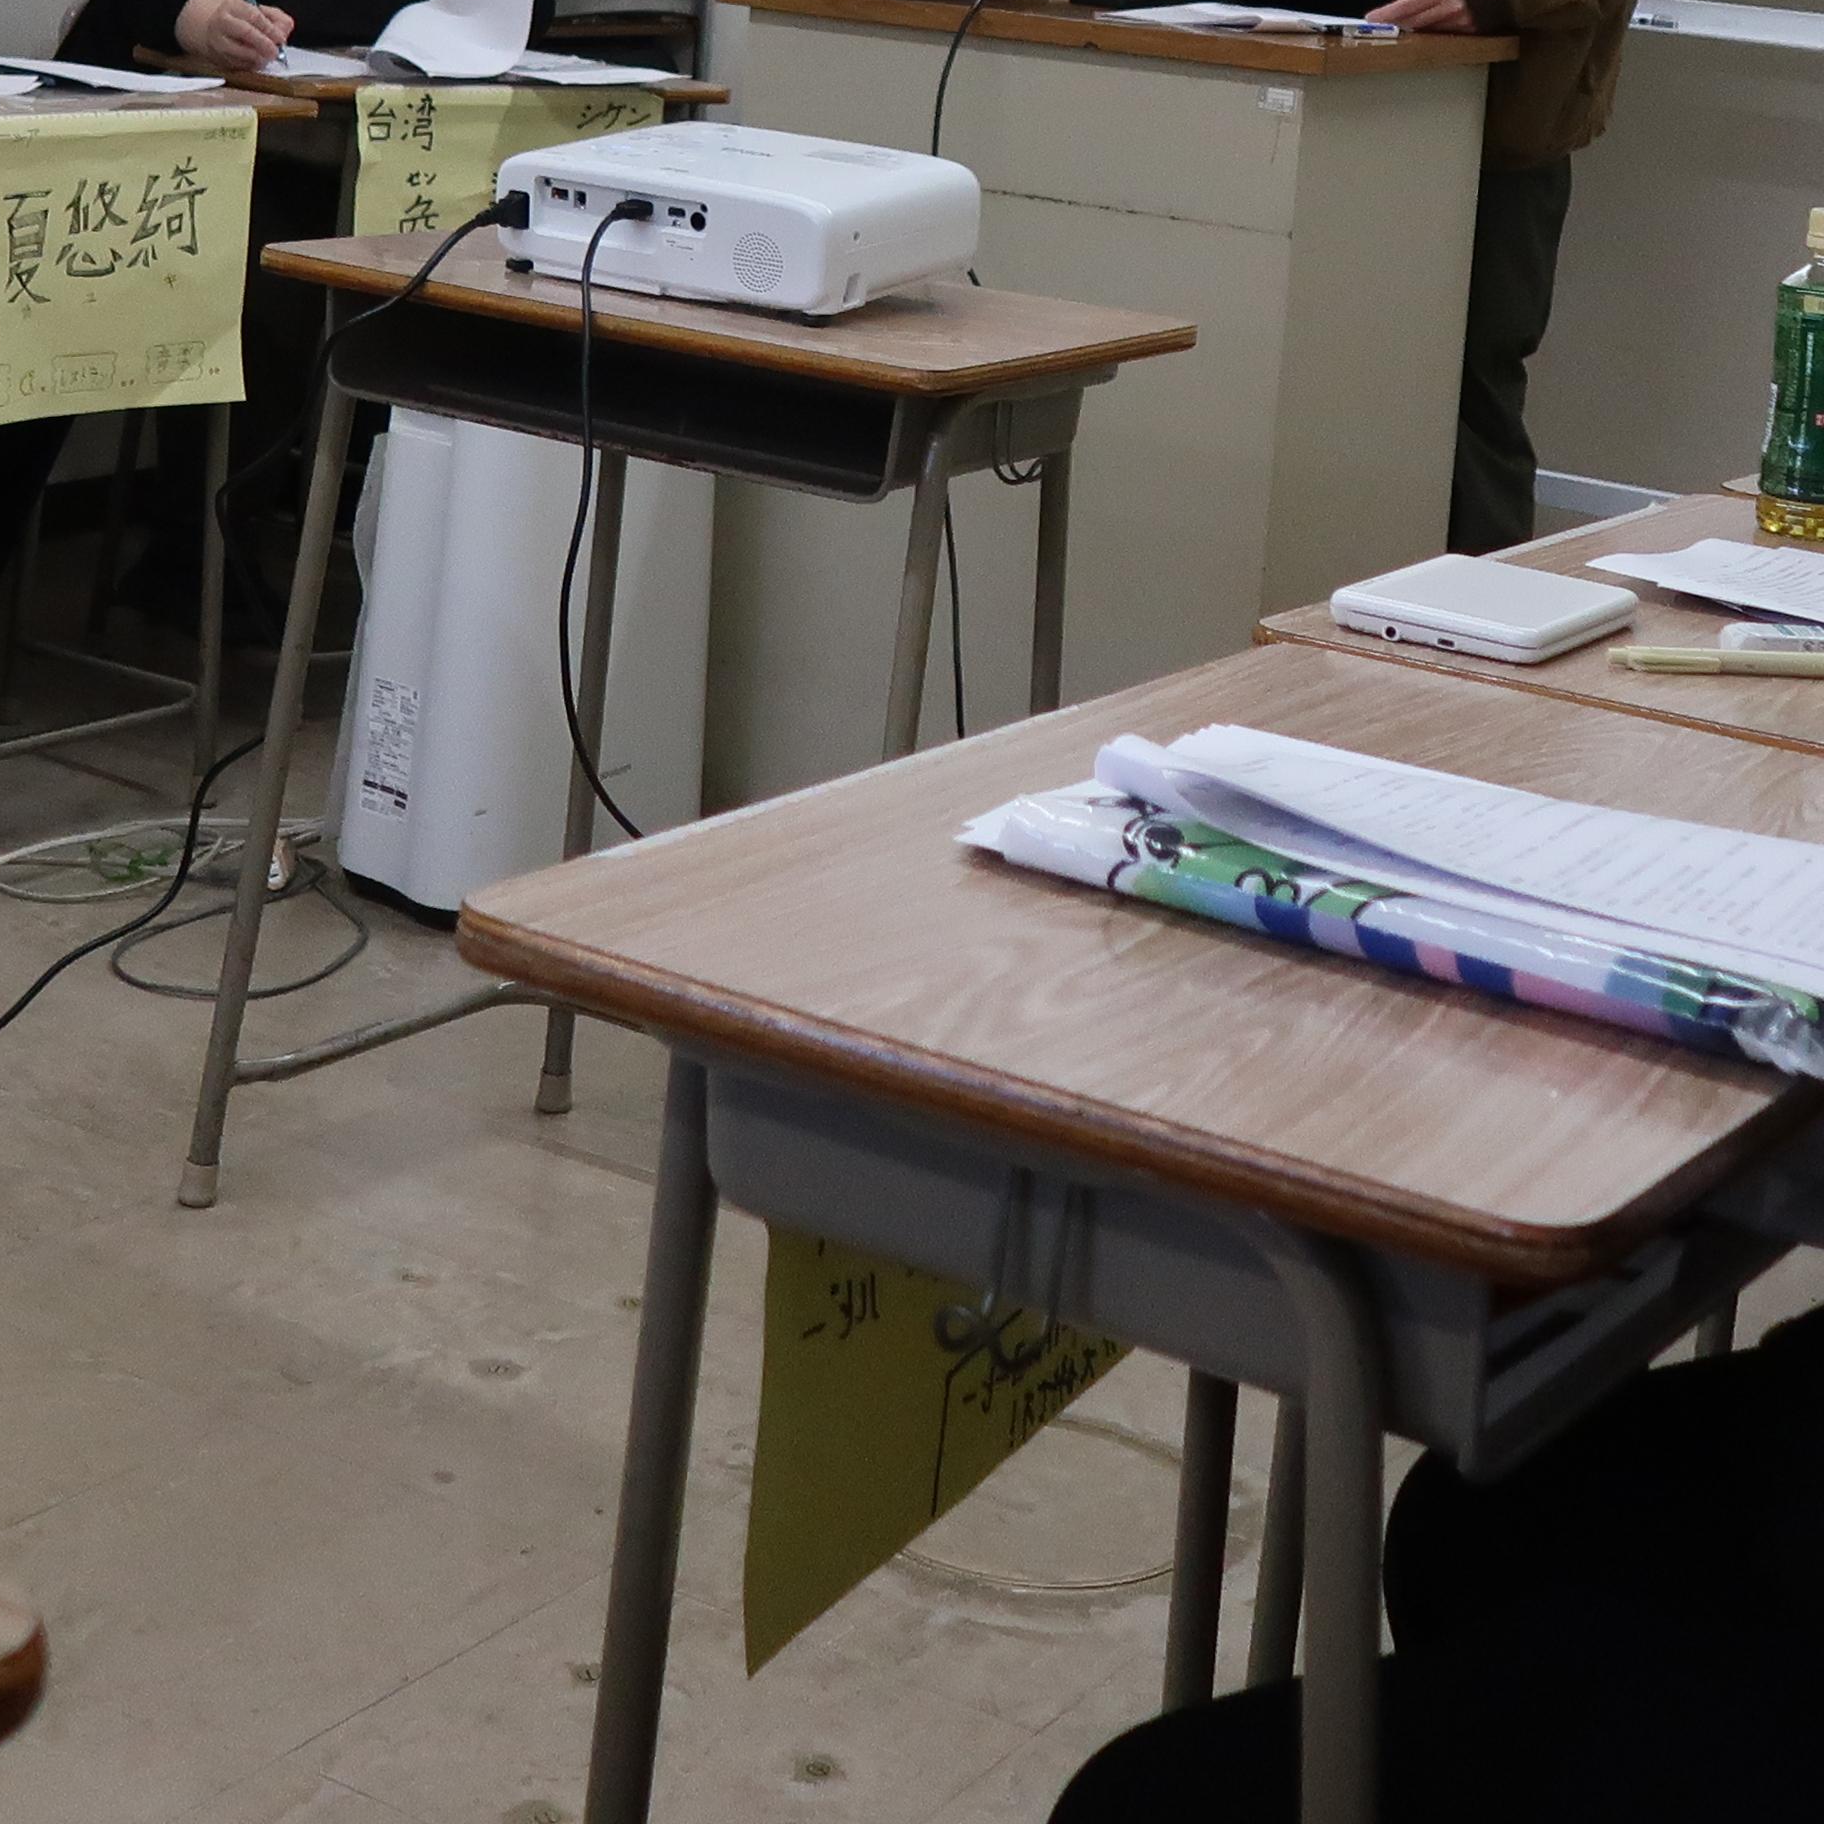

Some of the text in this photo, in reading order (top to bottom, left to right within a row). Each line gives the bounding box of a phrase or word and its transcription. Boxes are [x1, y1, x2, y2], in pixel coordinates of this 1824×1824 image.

[366, 93, 437, 151] 台湾
[3, 155, 209, 306] 夏悠綺
